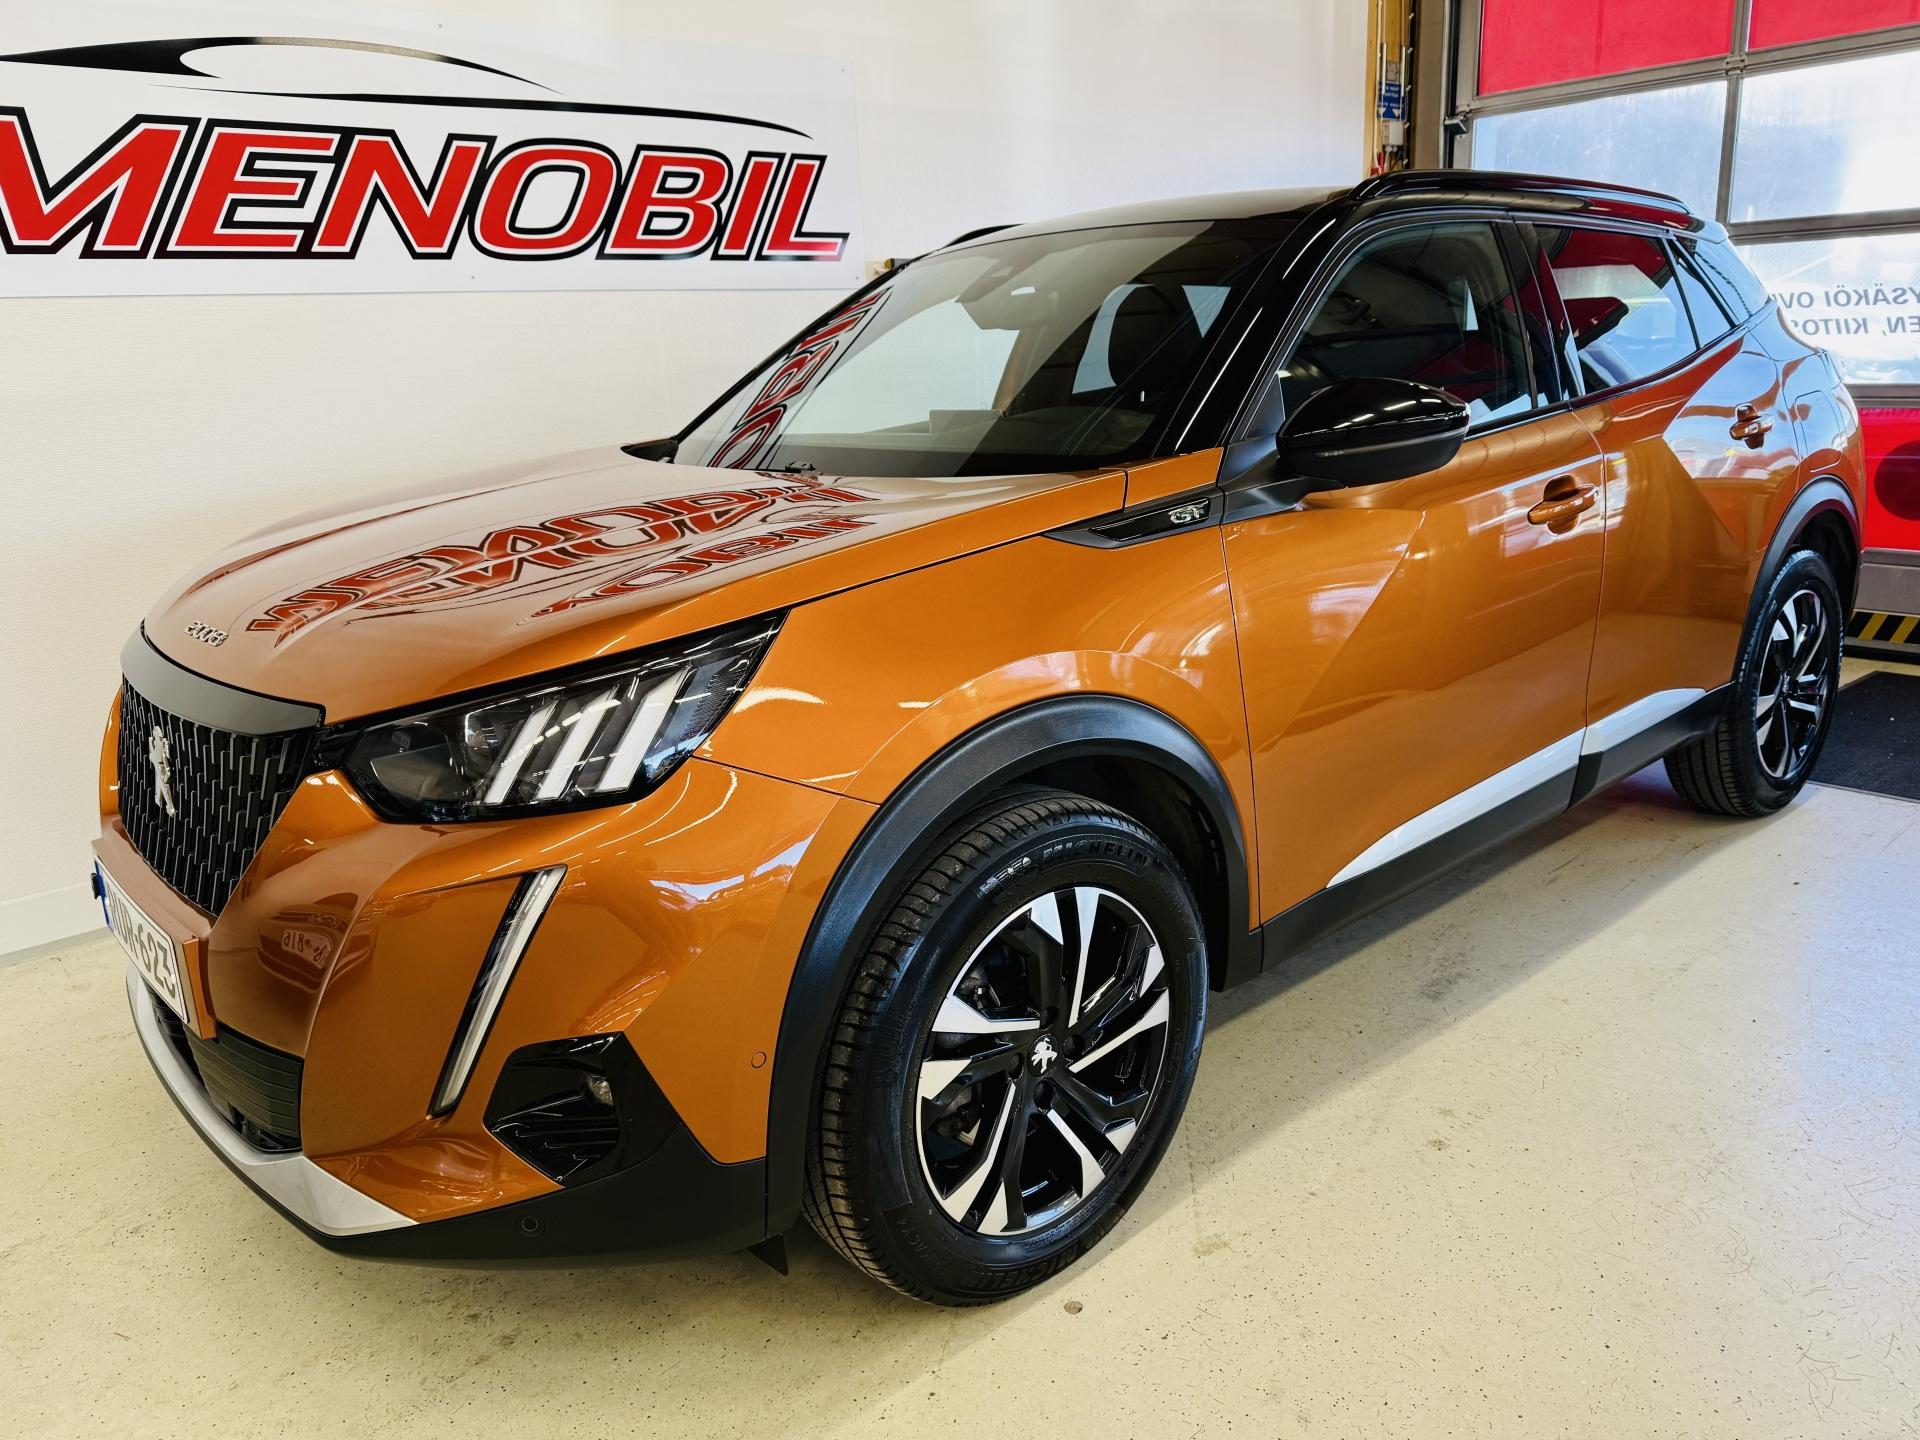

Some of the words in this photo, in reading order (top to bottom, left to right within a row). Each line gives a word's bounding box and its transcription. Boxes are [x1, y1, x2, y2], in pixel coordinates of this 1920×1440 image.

[0, 107, 849, 261] MENOBIL
[1168, 501, 1208, 523] GT
[184, 619, 228, 647] 2008
[1043, 839, 1154, 866] MICHELIN
